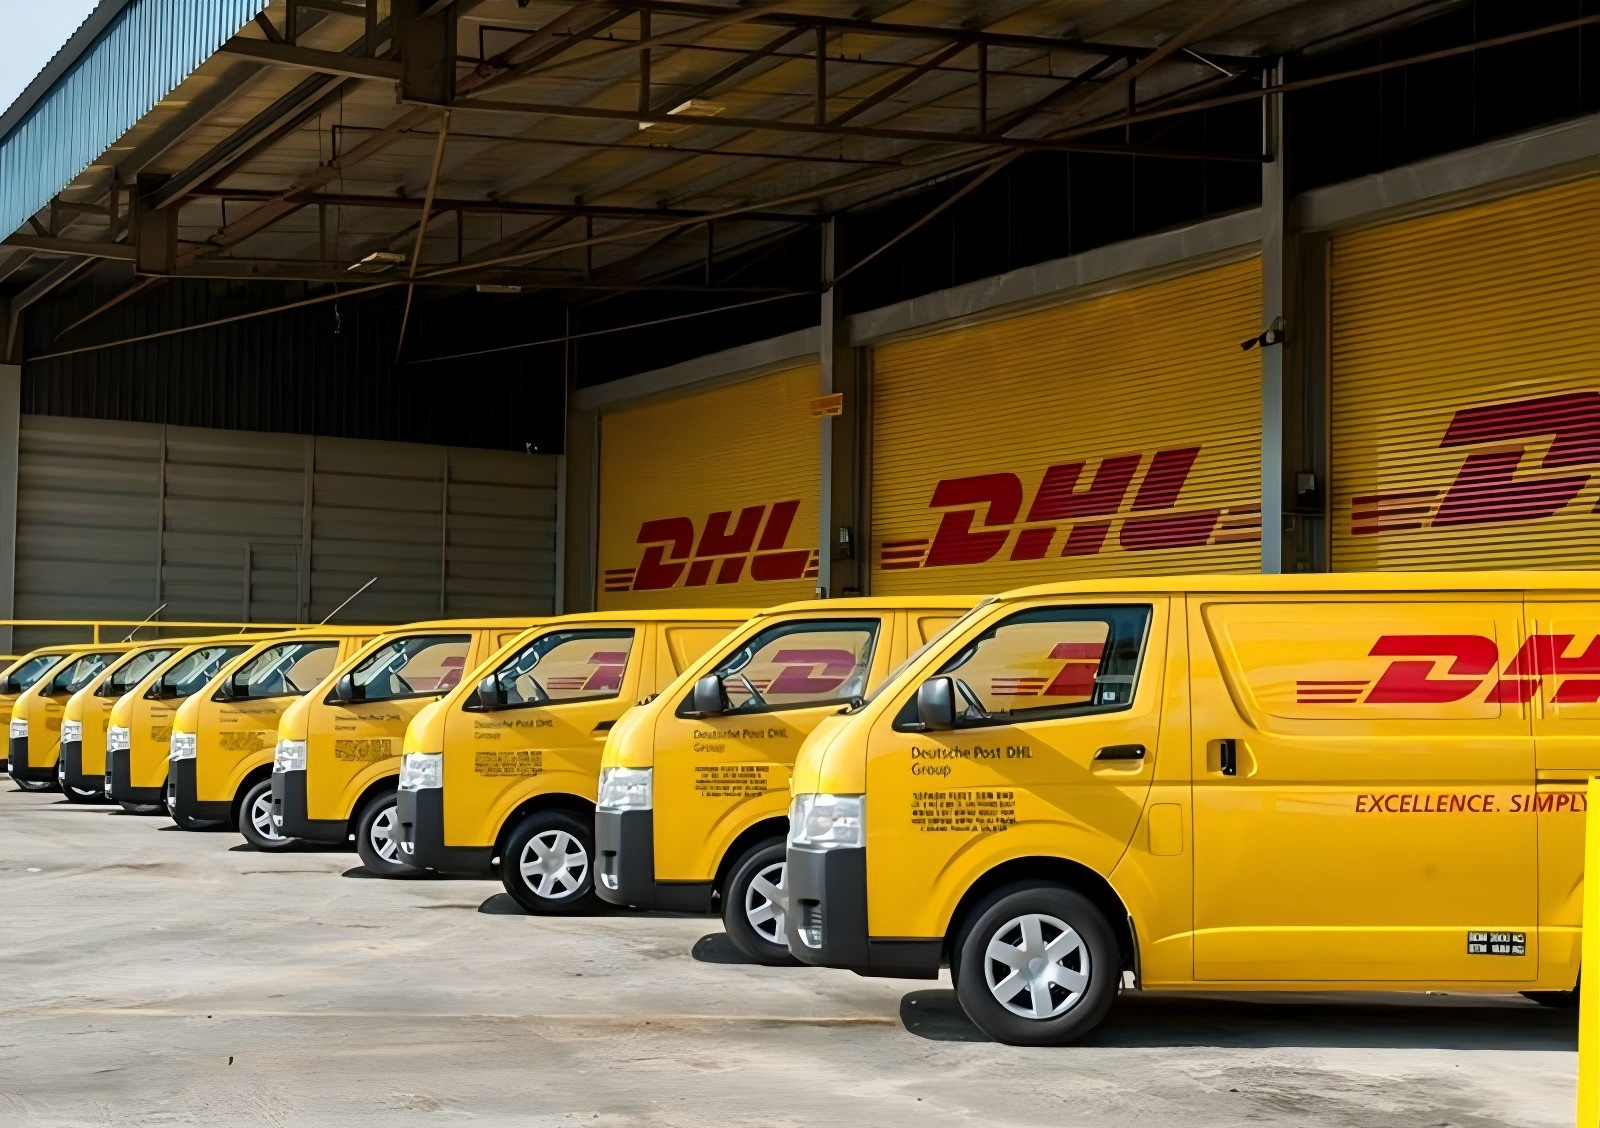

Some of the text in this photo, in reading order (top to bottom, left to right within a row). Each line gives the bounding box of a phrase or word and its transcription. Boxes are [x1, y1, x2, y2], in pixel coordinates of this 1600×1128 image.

[923, 446, 1221, 568] DHL
[632, 499, 811, 591] DHL
[911, 745, 1033, 760] Deutsche Post DHL
[911, 762, 952, 778] Group
[1355, 794, 1500, 813] EXCELLENCE.
